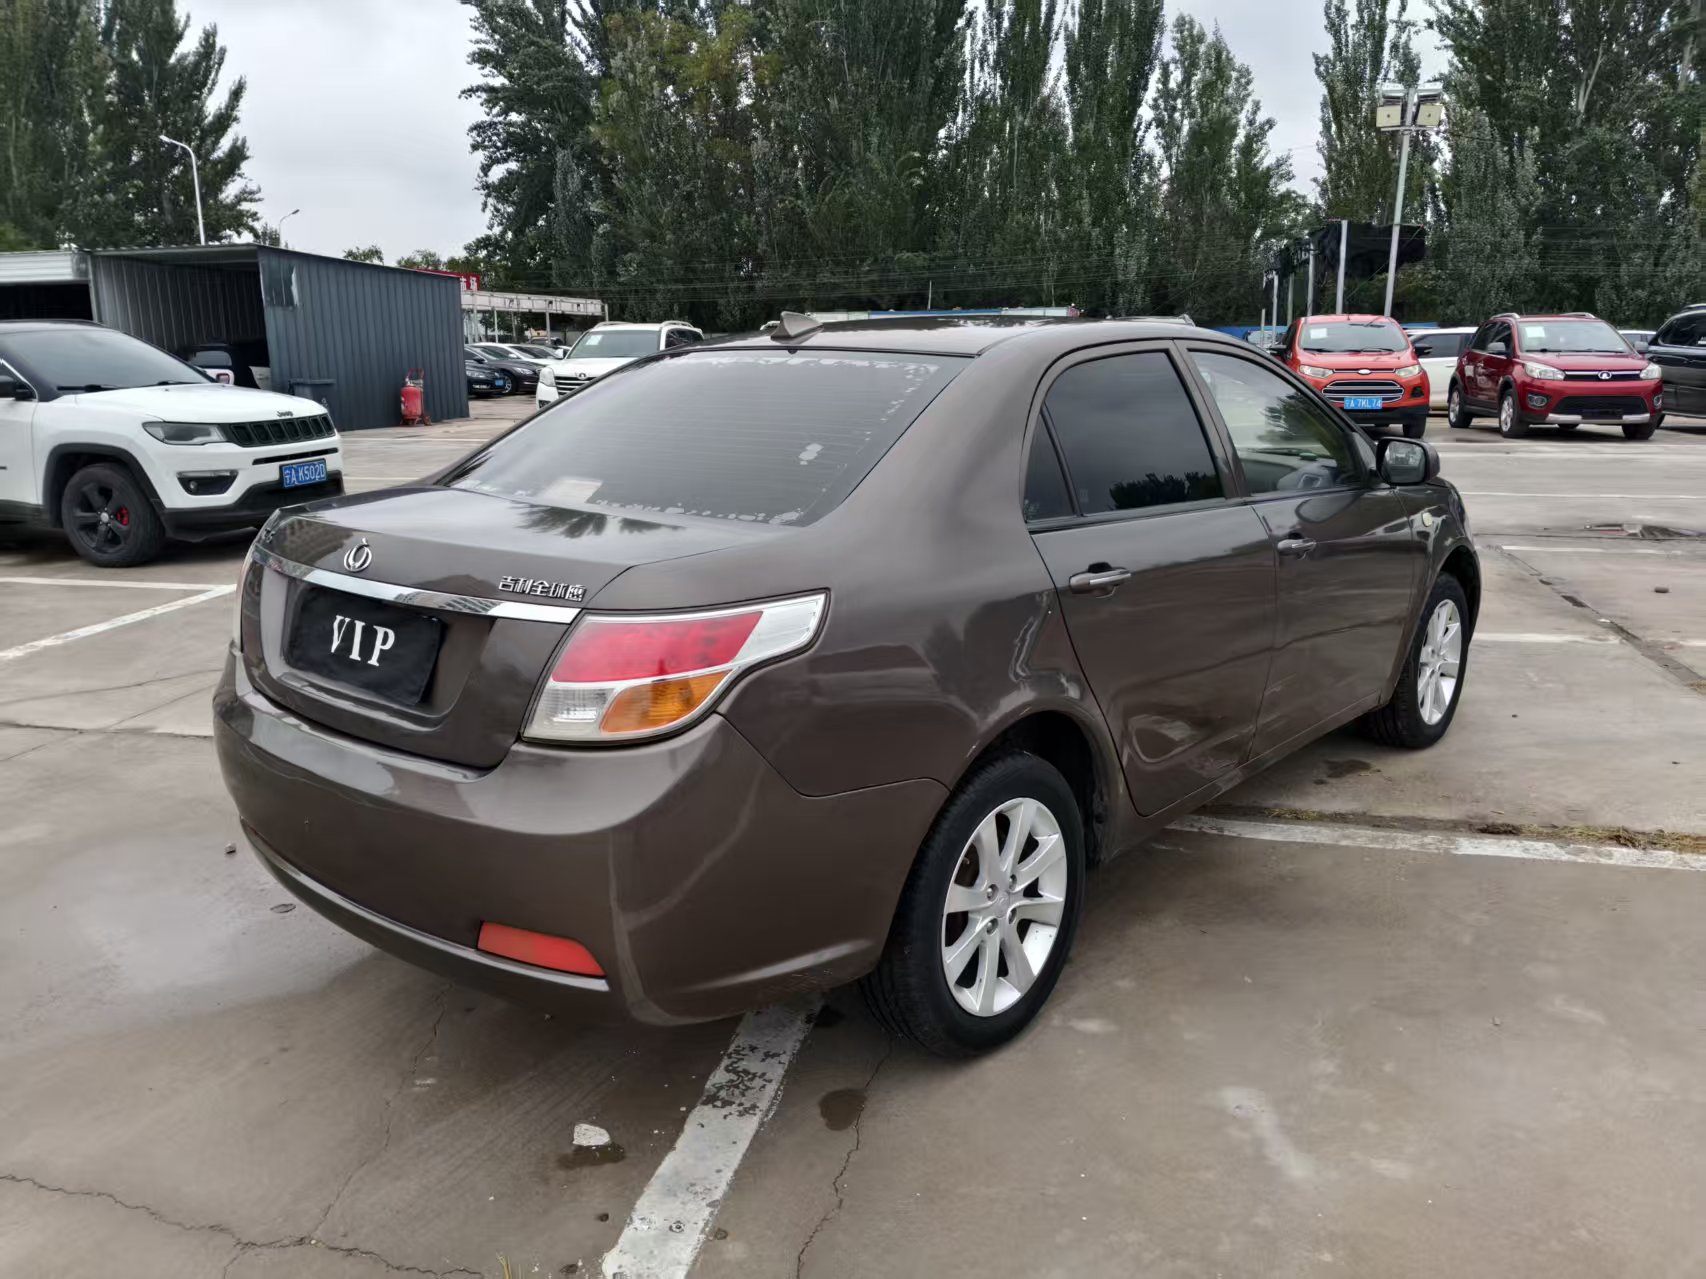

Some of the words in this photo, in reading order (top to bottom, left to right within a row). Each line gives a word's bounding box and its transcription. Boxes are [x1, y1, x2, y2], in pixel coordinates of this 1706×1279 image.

[498, 575, 586, 602] 吉利全球鹰
[330, 614, 396, 667] VIP
